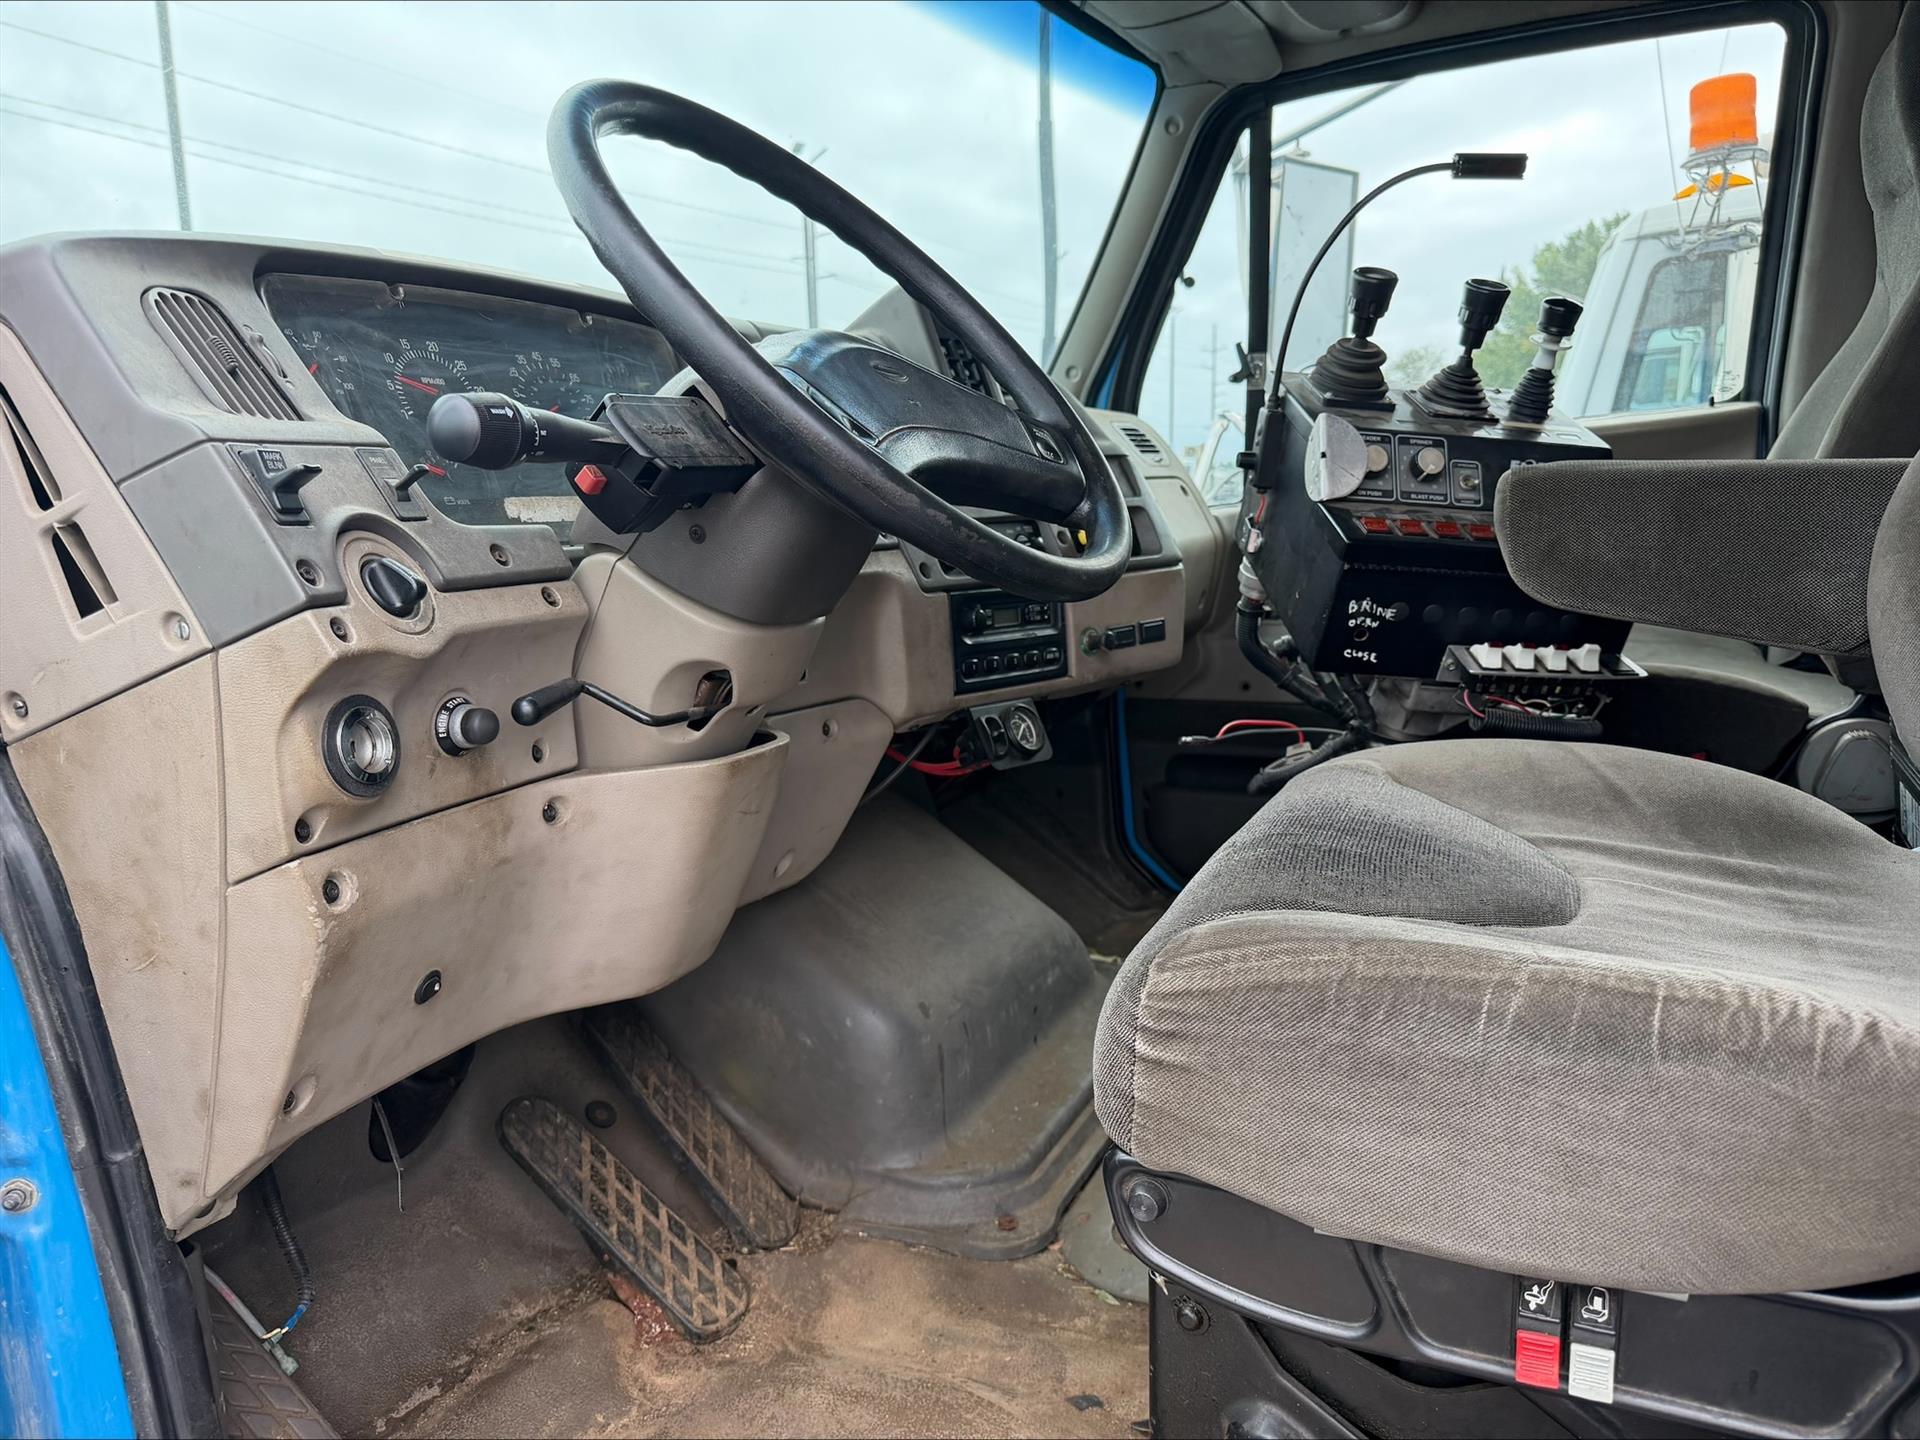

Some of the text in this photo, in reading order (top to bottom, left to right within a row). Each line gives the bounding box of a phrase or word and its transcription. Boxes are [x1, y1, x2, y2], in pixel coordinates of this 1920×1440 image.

[399, 338, 411, 350] 15
[426, 341, 439, 352] 20
[383, 352, 395, 364] 10
[454, 360, 467, 371] 25
[386, 379, 395, 391] 5
[262, 451, 283, 461] MARK
[266, 460, 285, 470] BLNK
[1348, 598, 1397, 621] BRINE
[1343, 648, 1378, 663] CLOSE
[438, 697, 466, 738] ENGINE START
